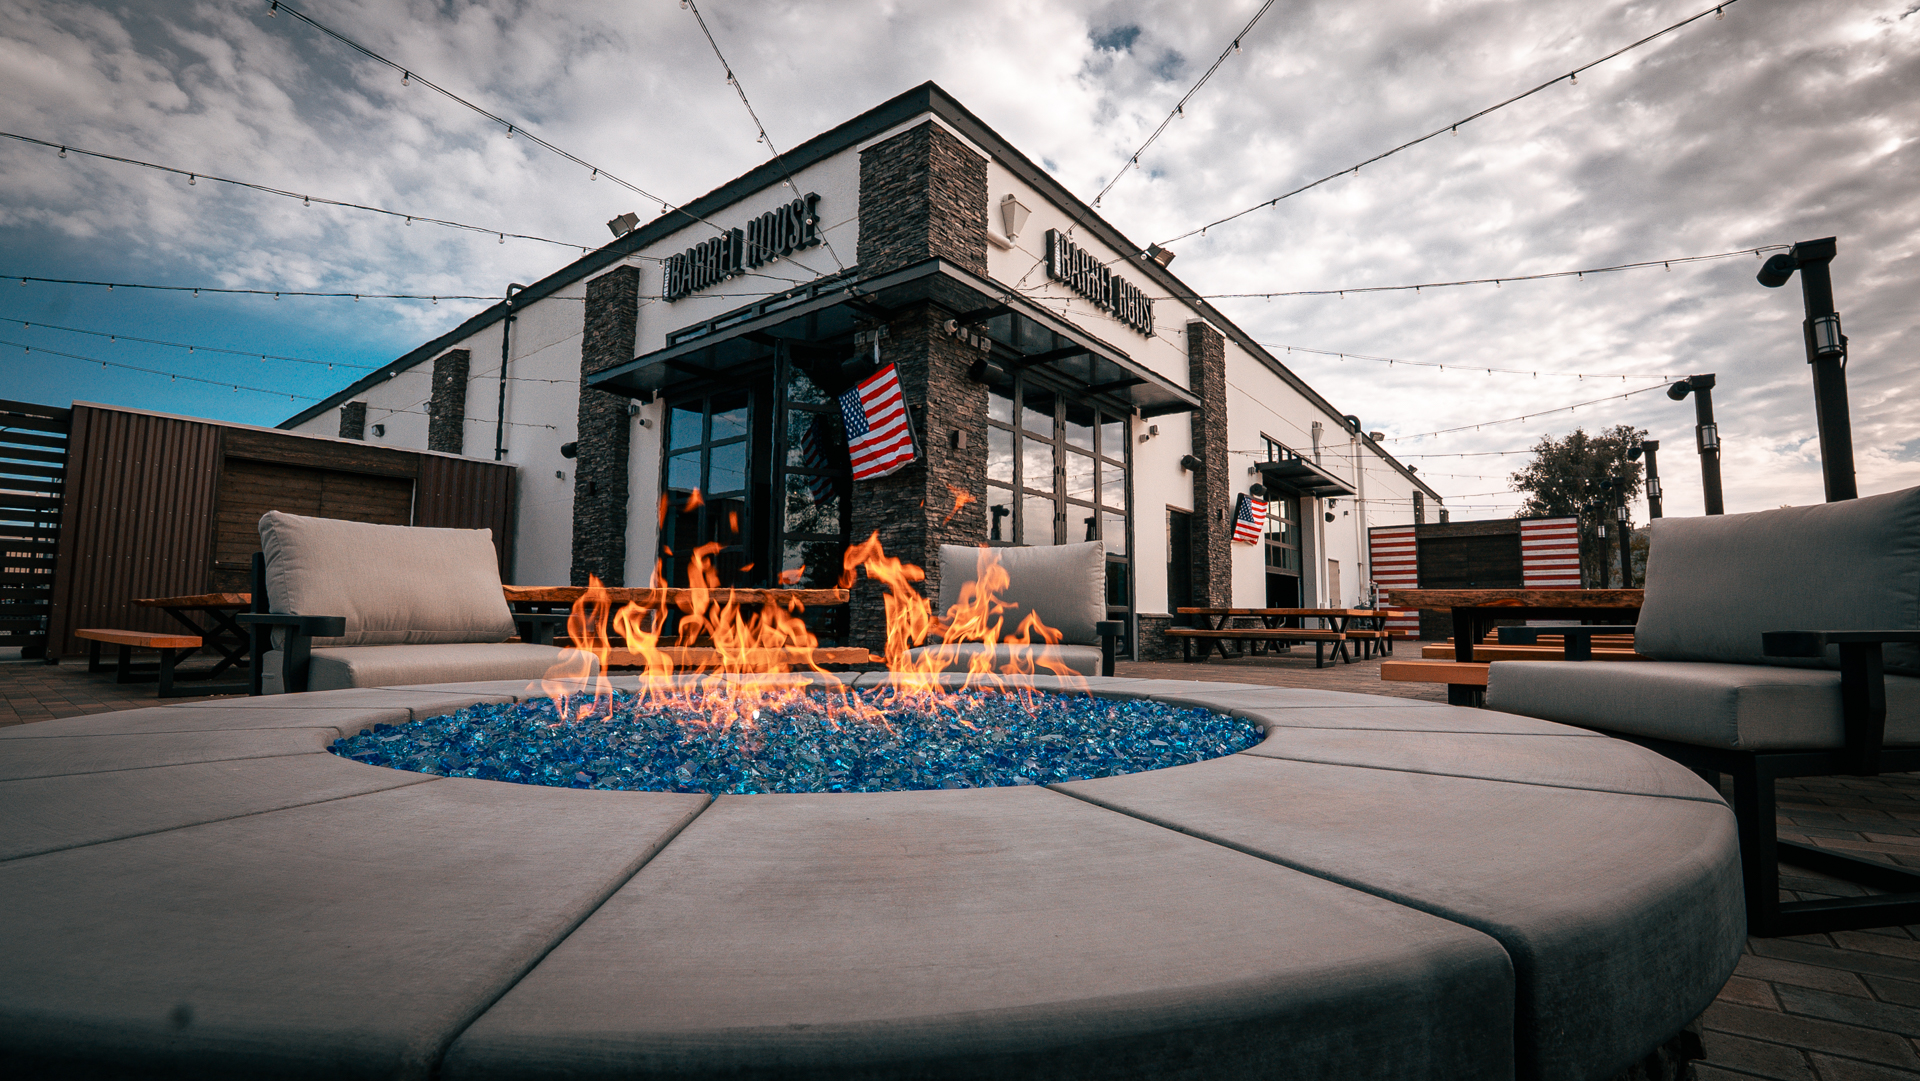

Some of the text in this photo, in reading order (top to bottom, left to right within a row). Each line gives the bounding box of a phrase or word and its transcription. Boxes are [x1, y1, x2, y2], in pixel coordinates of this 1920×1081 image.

[670, 192, 821, 302] BARREL HOUSE
[1060, 233, 1157, 337] BARREL HOUSE
